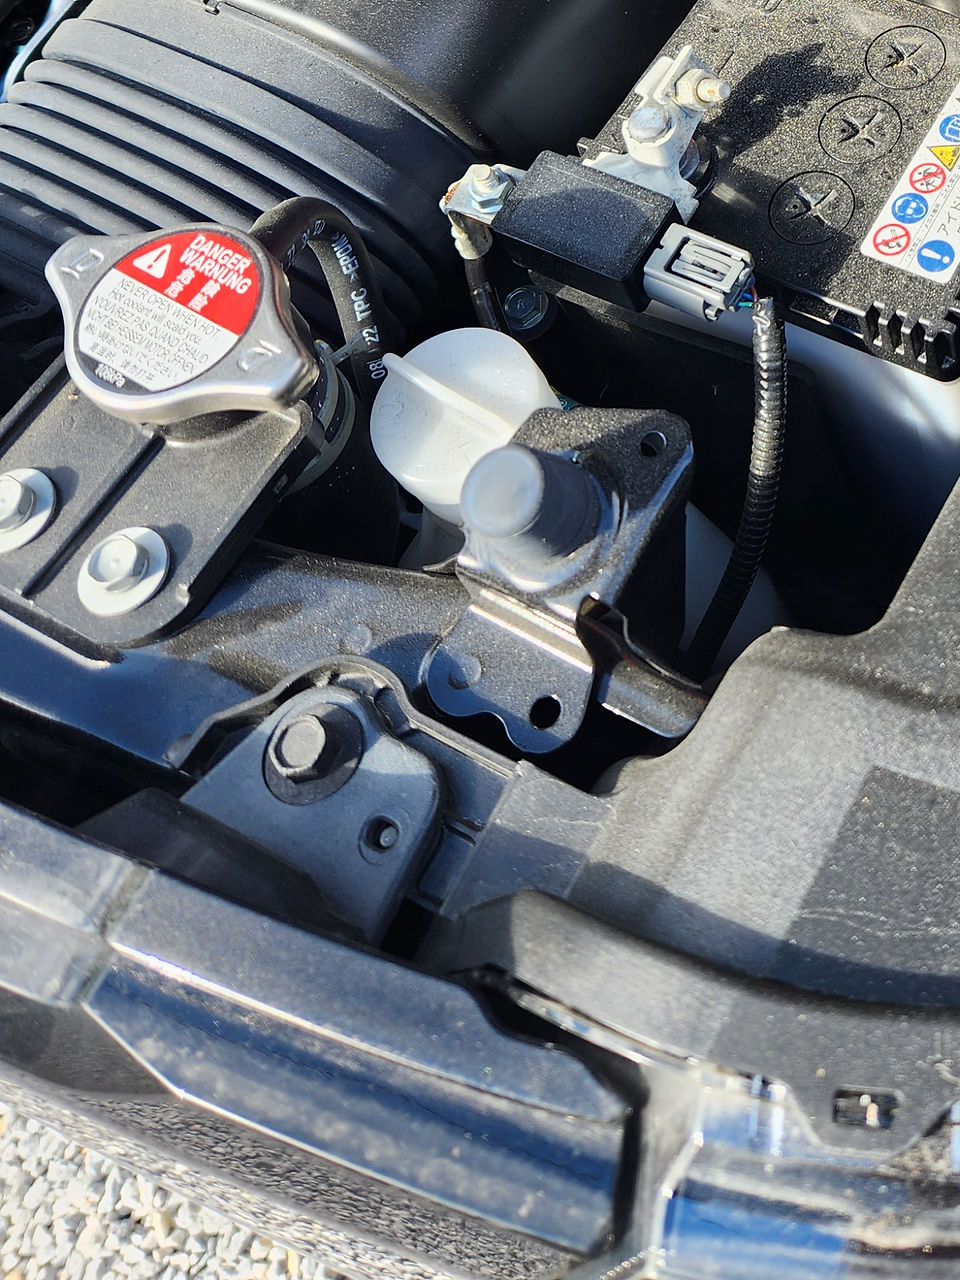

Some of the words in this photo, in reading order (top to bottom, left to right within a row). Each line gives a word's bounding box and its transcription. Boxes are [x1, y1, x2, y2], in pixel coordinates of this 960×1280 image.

[179, 247, 252, 294] WARNUNG
[190, 234, 252, 274] DANGER
[118, 279, 149, 300] NEVER
[147, 294, 176, 313] OPEN
[173, 309, 202, 328] WHEN
[351, 287, 372, 322] TPC
[362, 325, 380, 344] 22
